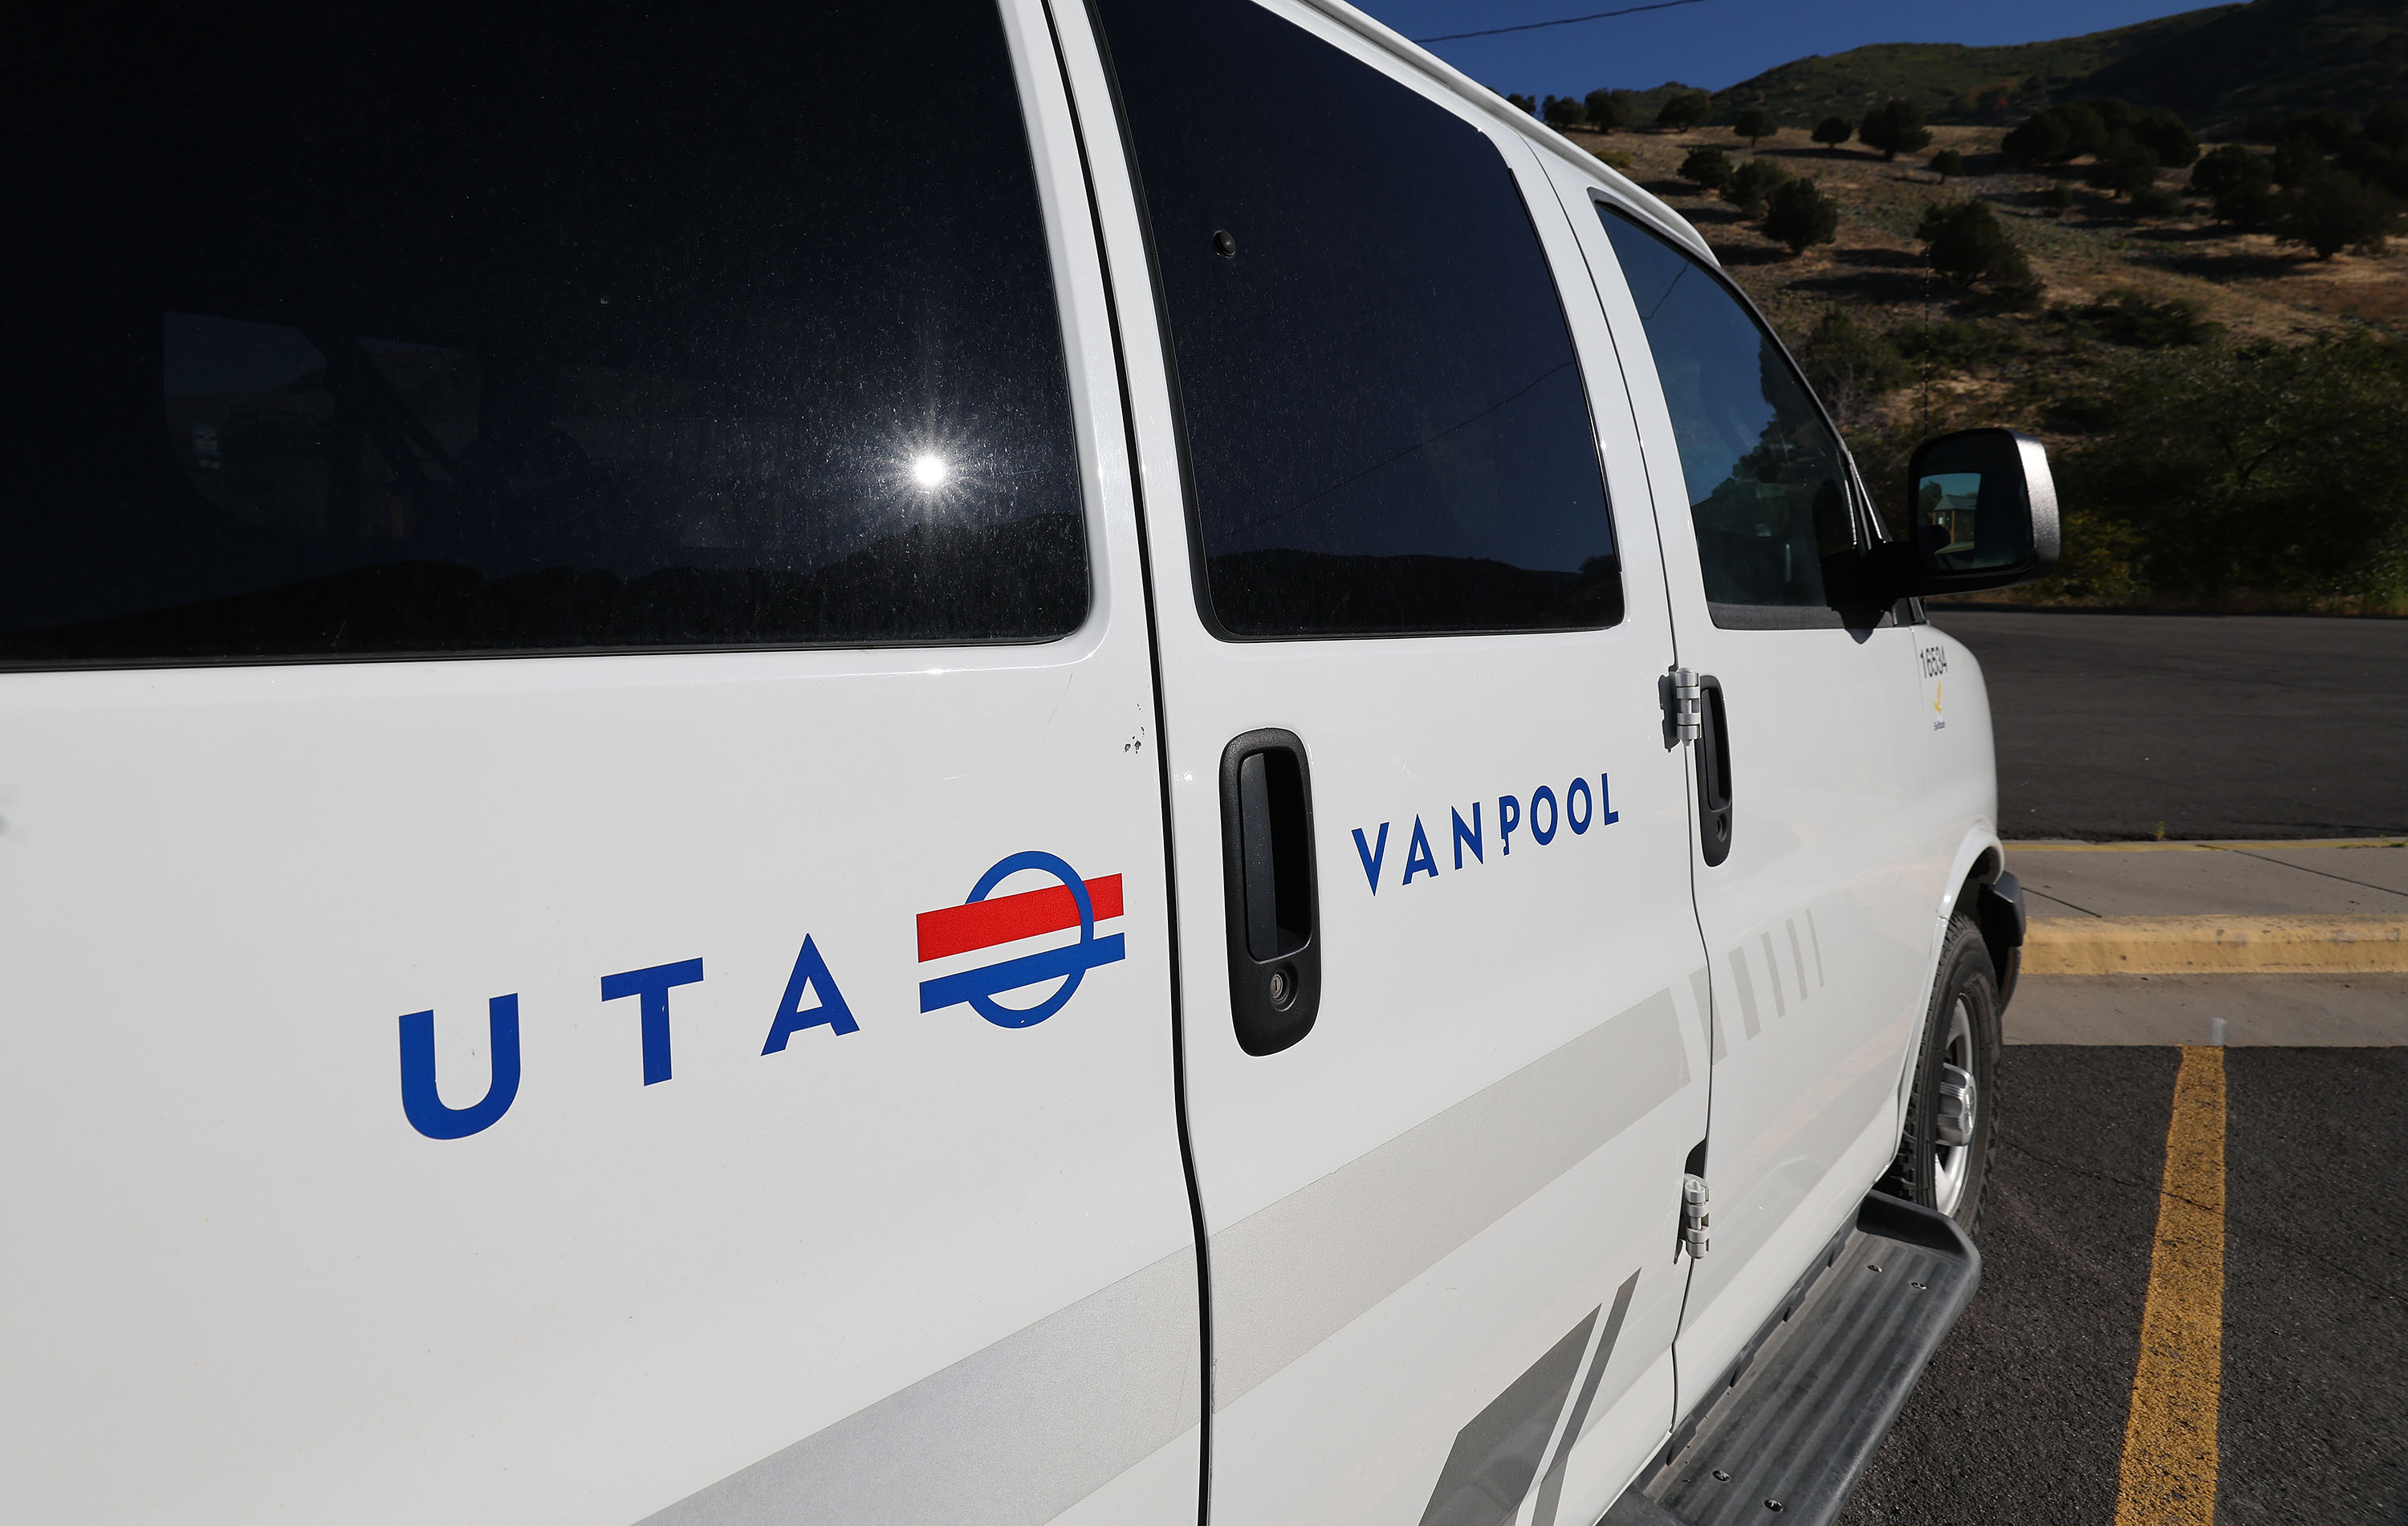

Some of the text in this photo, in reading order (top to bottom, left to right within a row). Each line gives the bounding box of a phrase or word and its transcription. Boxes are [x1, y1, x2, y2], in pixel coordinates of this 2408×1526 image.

[1920, 645, 1948, 678] 16534
[1351, 772, 1619, 897] VANPOOL
[398, 933, 860, 1140] UTA
